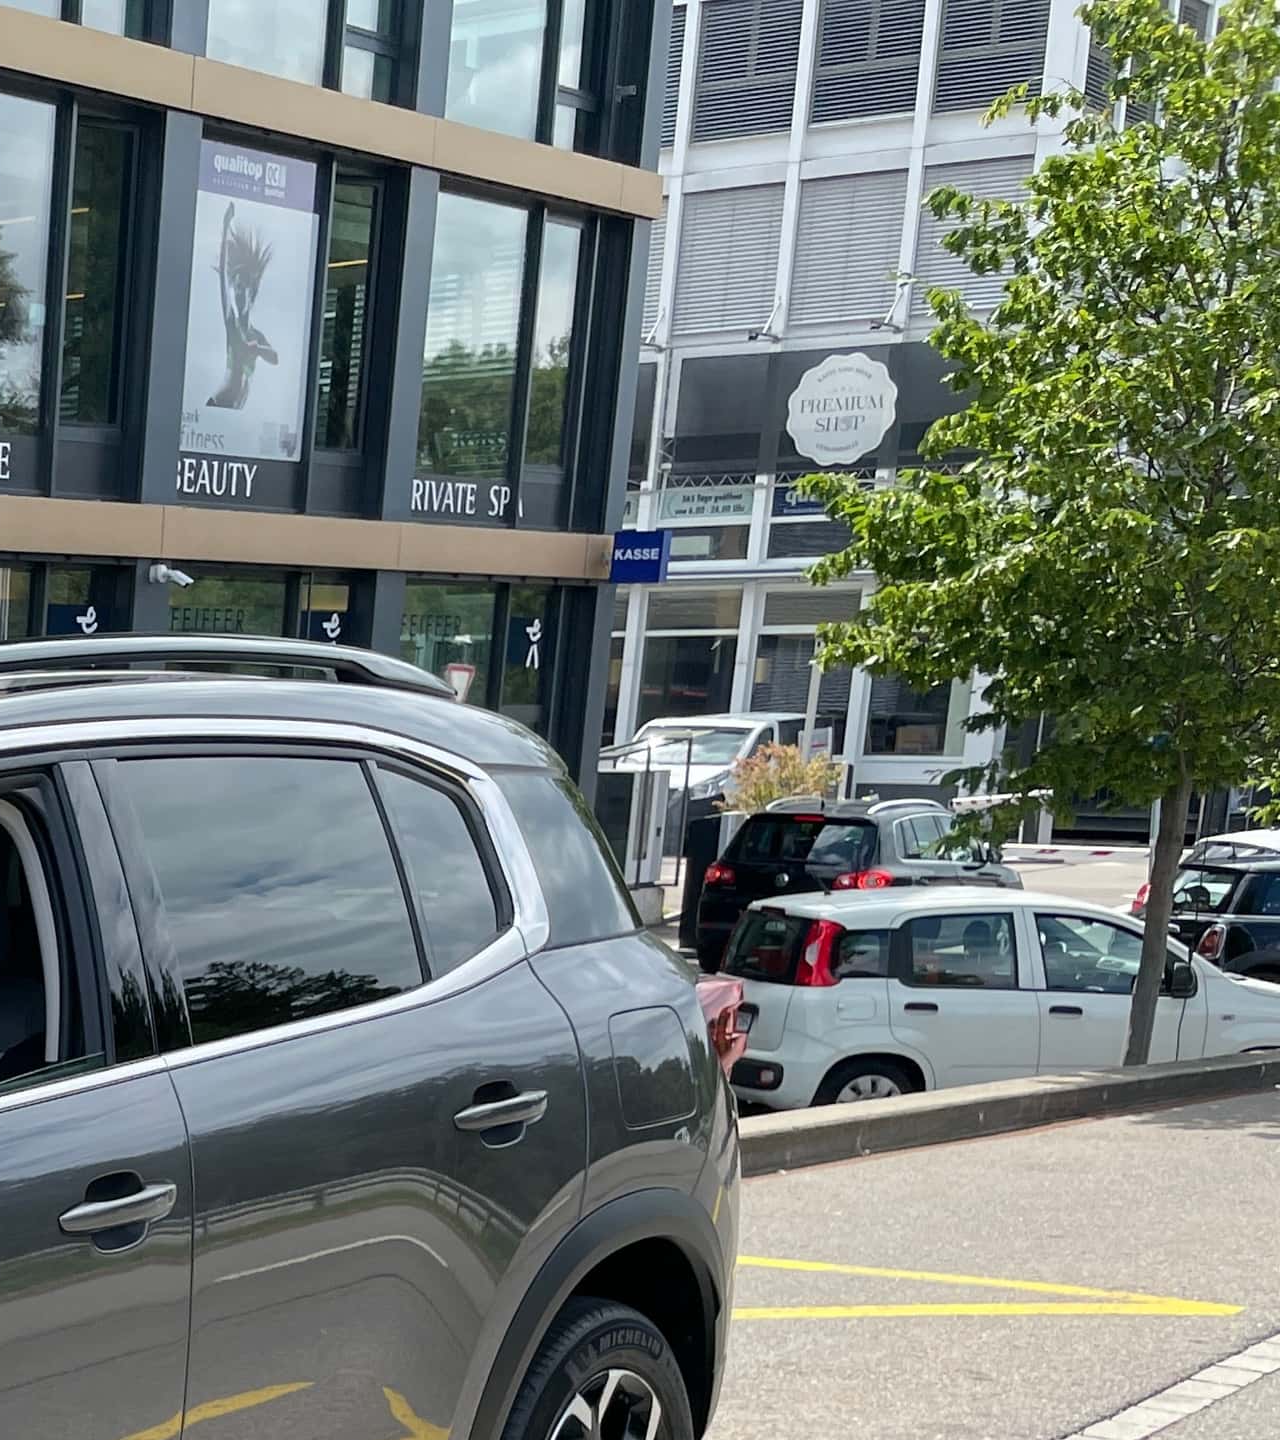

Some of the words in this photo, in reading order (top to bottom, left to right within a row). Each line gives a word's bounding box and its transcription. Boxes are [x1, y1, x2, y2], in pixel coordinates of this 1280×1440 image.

[213, 154, 263, 181] qualitop
[800, 393, 884, 414] PREMIUM
[487, 484, 523, 518] SP
[614, 547, 660, 561] KASSE
[598, 1327, 662, 1357] MICHELIN
